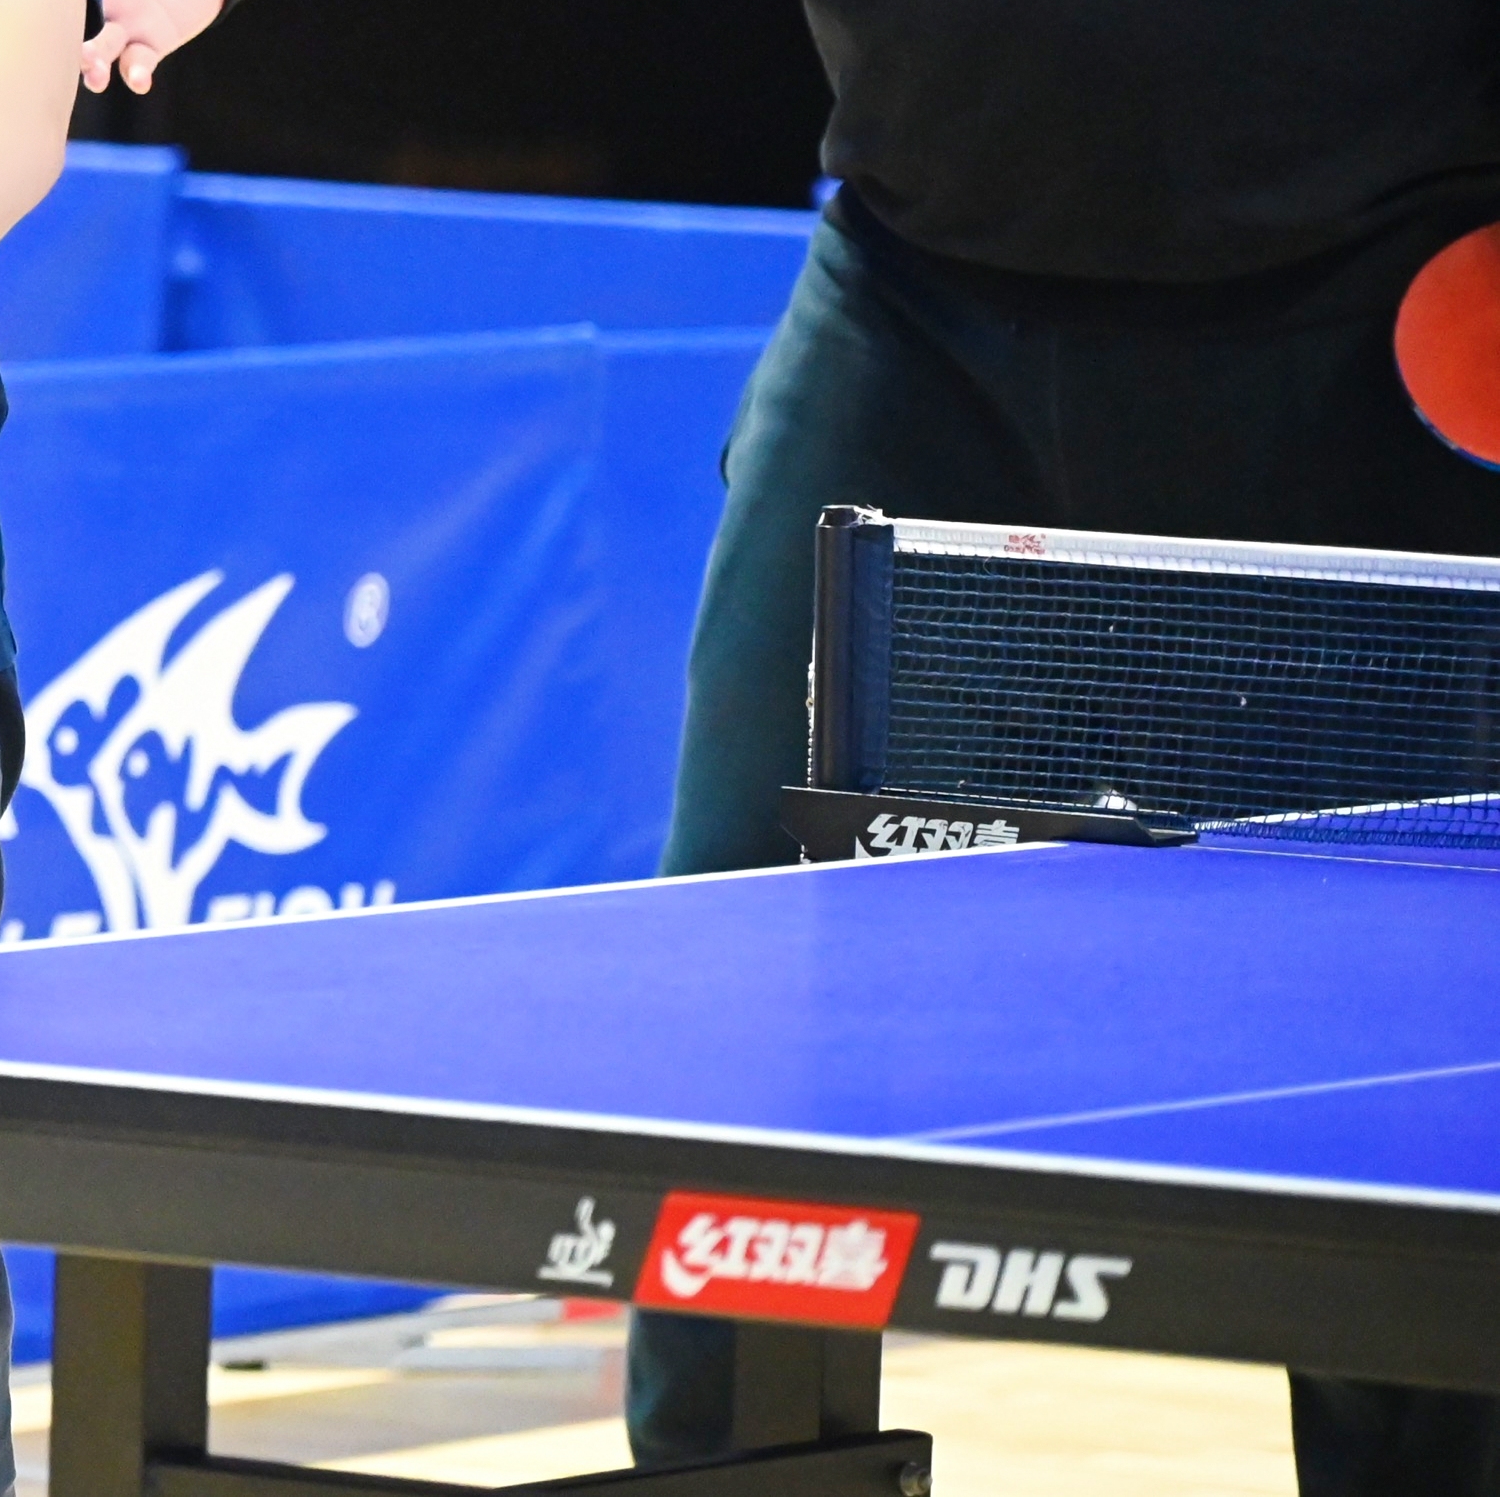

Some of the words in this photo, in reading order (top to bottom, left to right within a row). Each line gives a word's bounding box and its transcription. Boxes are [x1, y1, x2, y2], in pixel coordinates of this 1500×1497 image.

[662, 1212, 888, 1297] 红双喜
[930, 1241, 1132, 1323] DHS
